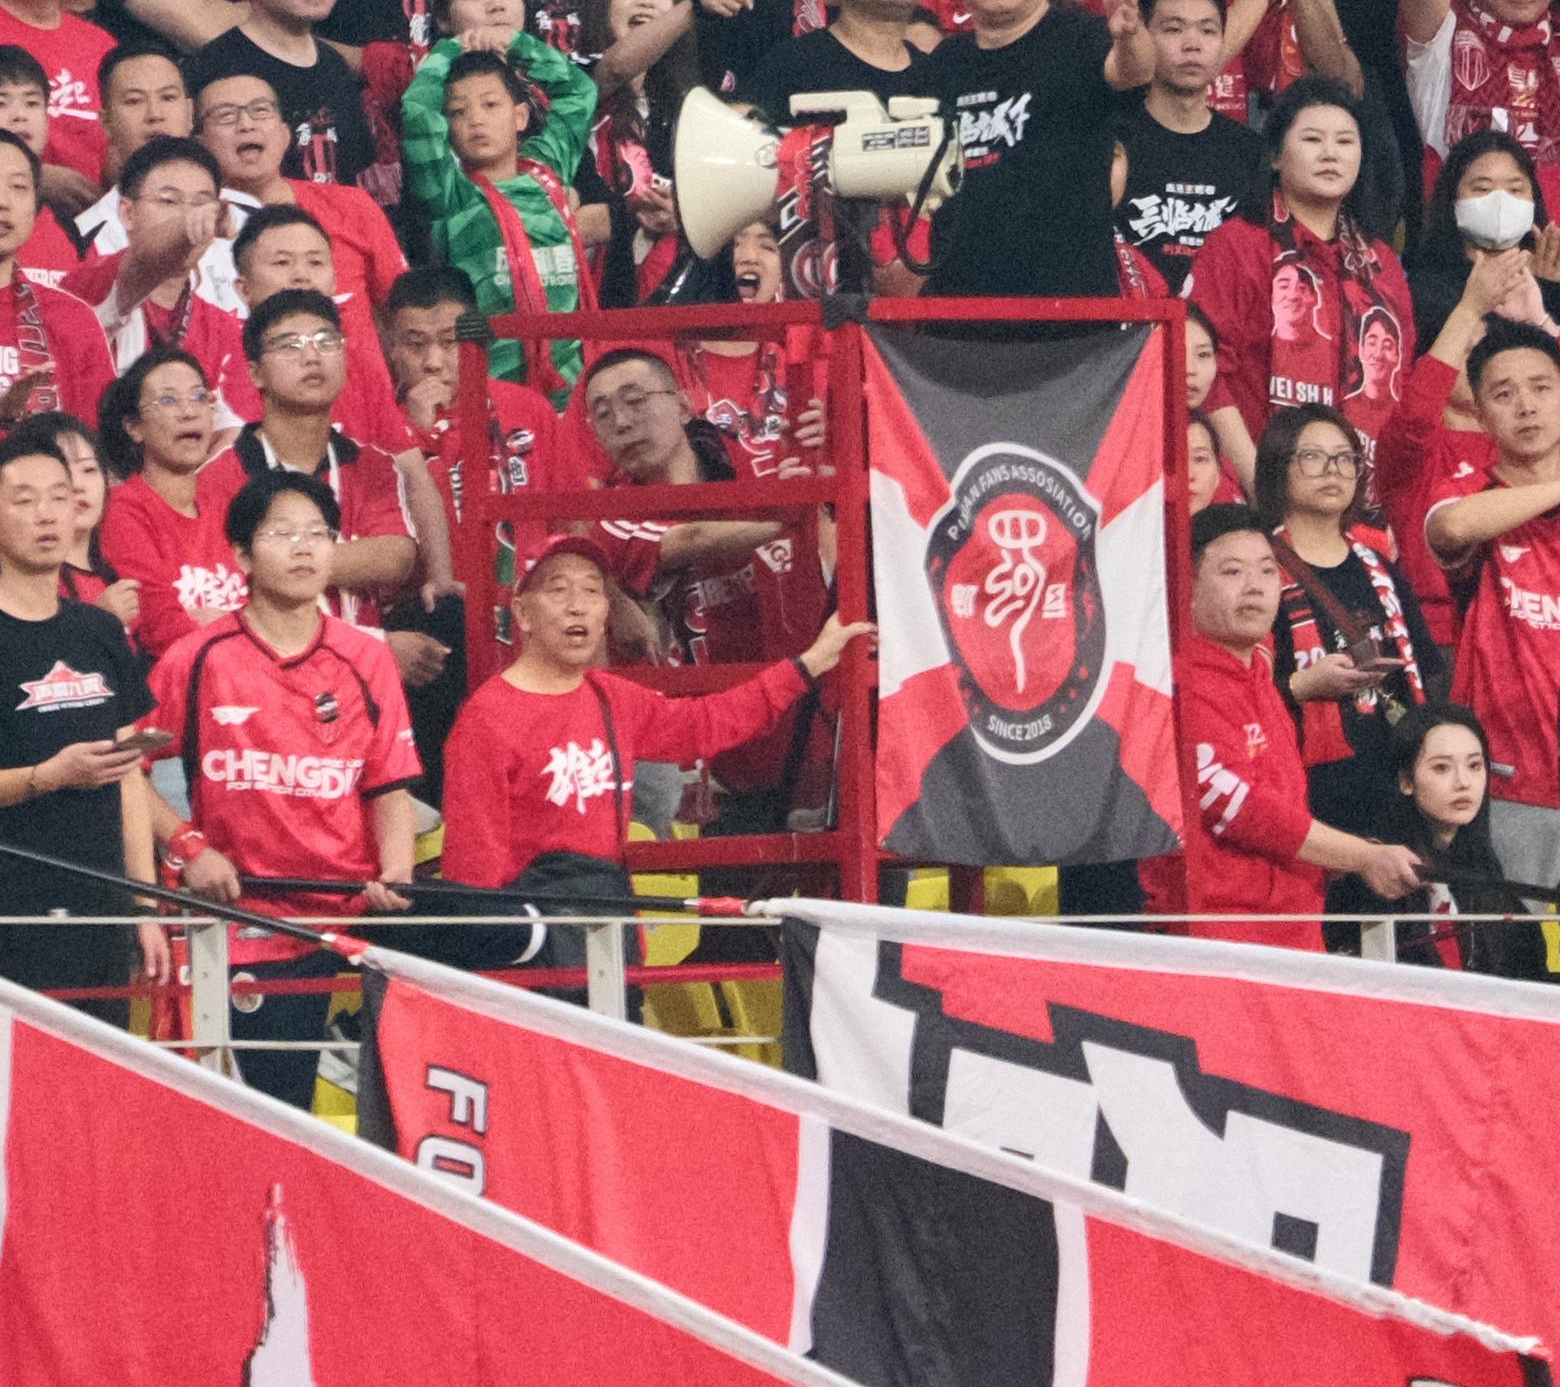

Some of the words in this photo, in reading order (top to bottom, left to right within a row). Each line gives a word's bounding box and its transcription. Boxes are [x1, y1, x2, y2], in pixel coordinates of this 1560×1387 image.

[46, 69, 98, 120] 起
[982, 470, 1011, 496] FANS
[989, 715, 1025, 743] SINCE
[1025, 713, 1053, 740] 2018
[202, 749, 363, 800] CHENGDU
